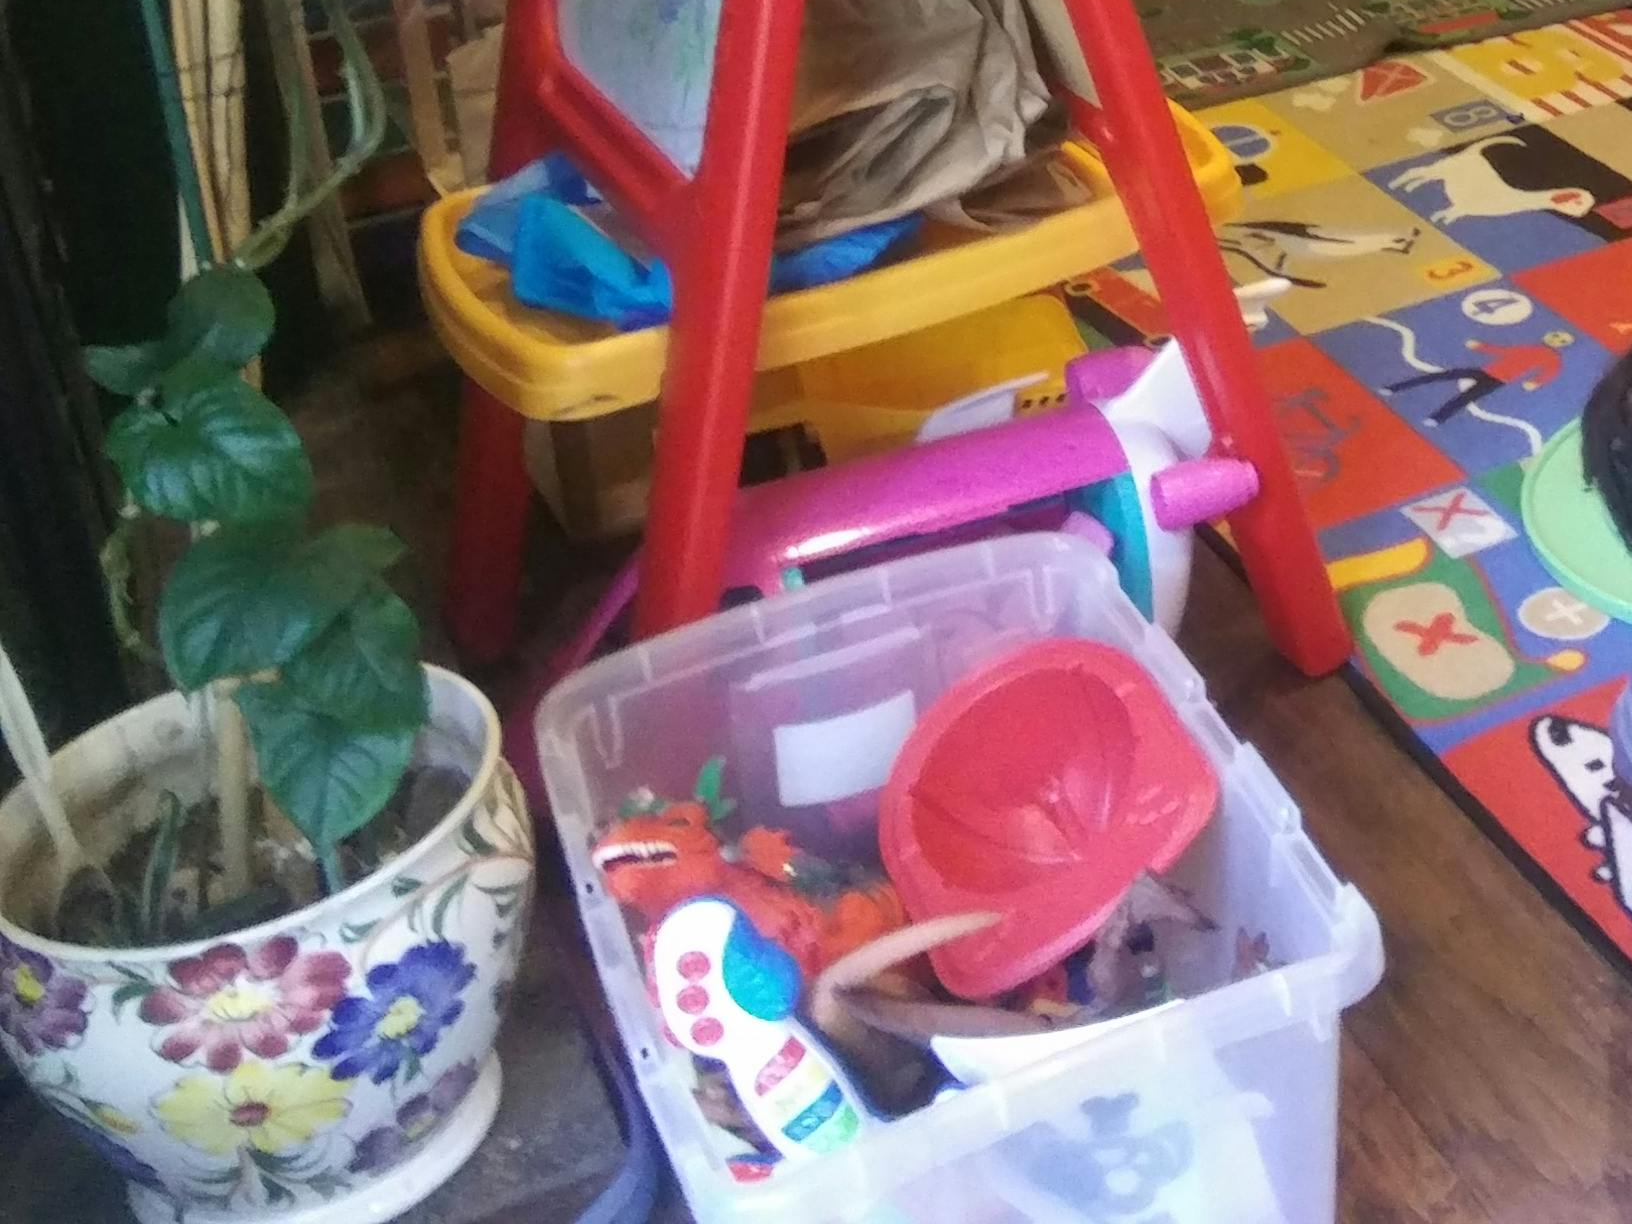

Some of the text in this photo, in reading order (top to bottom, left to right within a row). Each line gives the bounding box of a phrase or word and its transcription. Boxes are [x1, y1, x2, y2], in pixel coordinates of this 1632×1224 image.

[1443, 107, 1496, 127] 8
[1428, 260, 1473, 280] 3
[1473, 298, 1519, 315] 4
